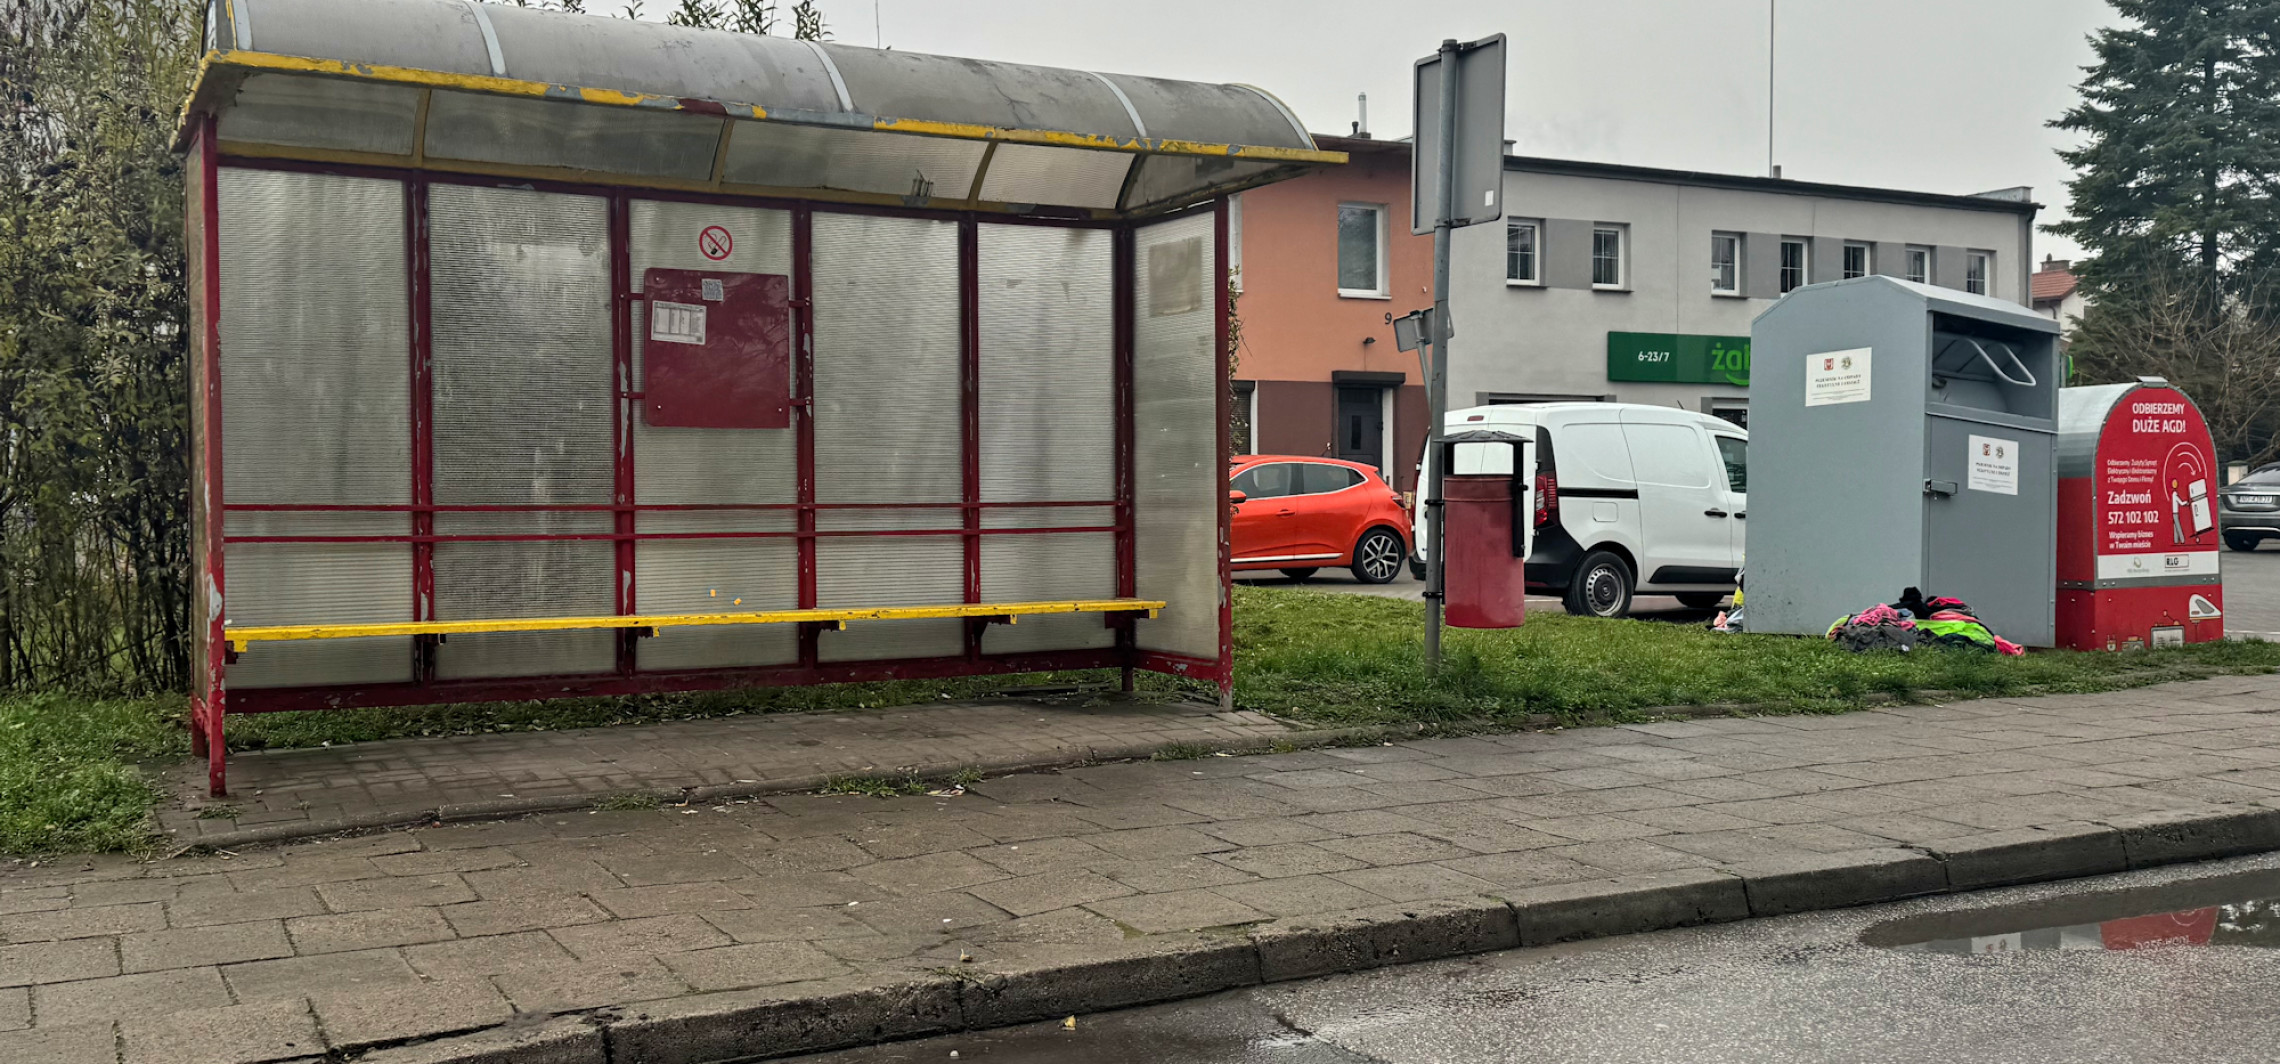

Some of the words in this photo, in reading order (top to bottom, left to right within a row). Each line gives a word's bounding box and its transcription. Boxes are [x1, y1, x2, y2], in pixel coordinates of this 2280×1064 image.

[1384, 312, 1393, 325] 9
[1638, 351, 1670, 362] 6-23/7
[2132, 402, 2185, 414] ODBIERZEMY
[2132, 416, 2160, 433] DUŻE
[2162, 419, 2187, 433] AGD!
[2107, 489, 2152, 505] Zadzwoń
[2108, 511, 2124, 525] 572
[2126, 511, 2142, 524] 102
[2143, 510, 2159, 524] 102
